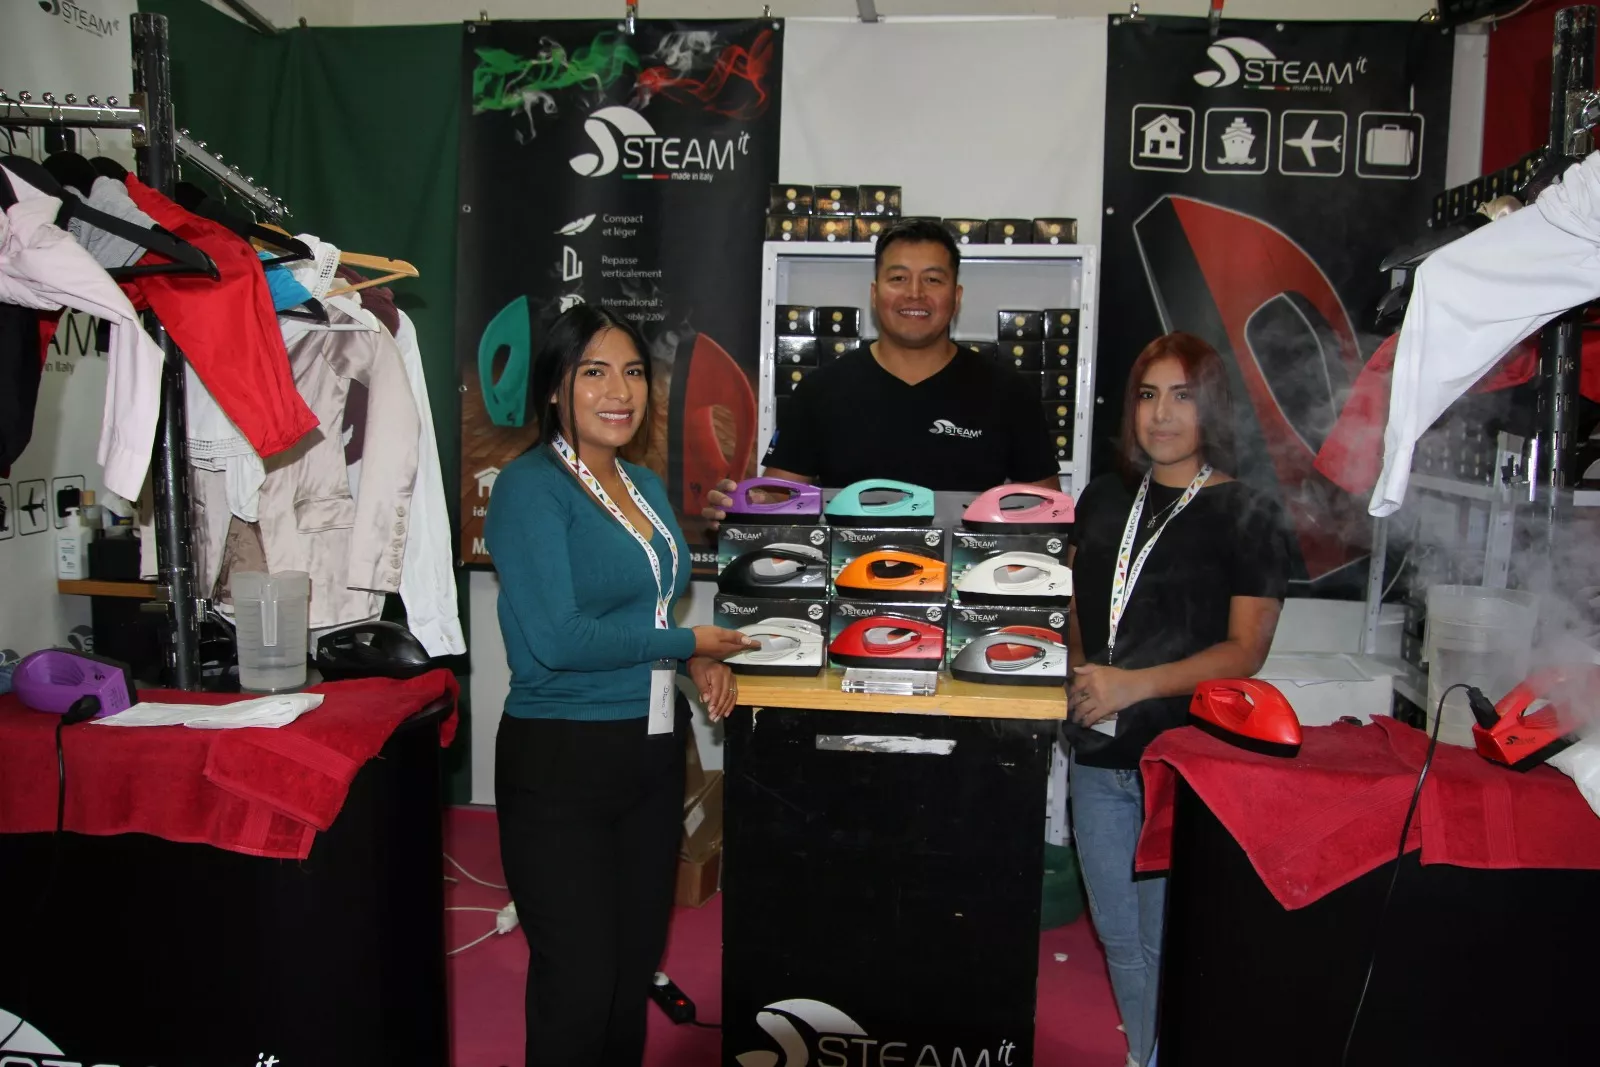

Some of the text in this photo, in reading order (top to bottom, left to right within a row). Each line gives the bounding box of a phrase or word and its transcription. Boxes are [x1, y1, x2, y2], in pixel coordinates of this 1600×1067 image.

[671, 171, 690, 181] made
[602, 213, 643, 224] Compact
[602, 226, 637, 239] et léger
[601, 255, 638, 267] Repasse
[601, 269, 662, 278] verticalement
[601, 297, 658, 307] International
[1124, 503, 1142, 545] FEMOGA
